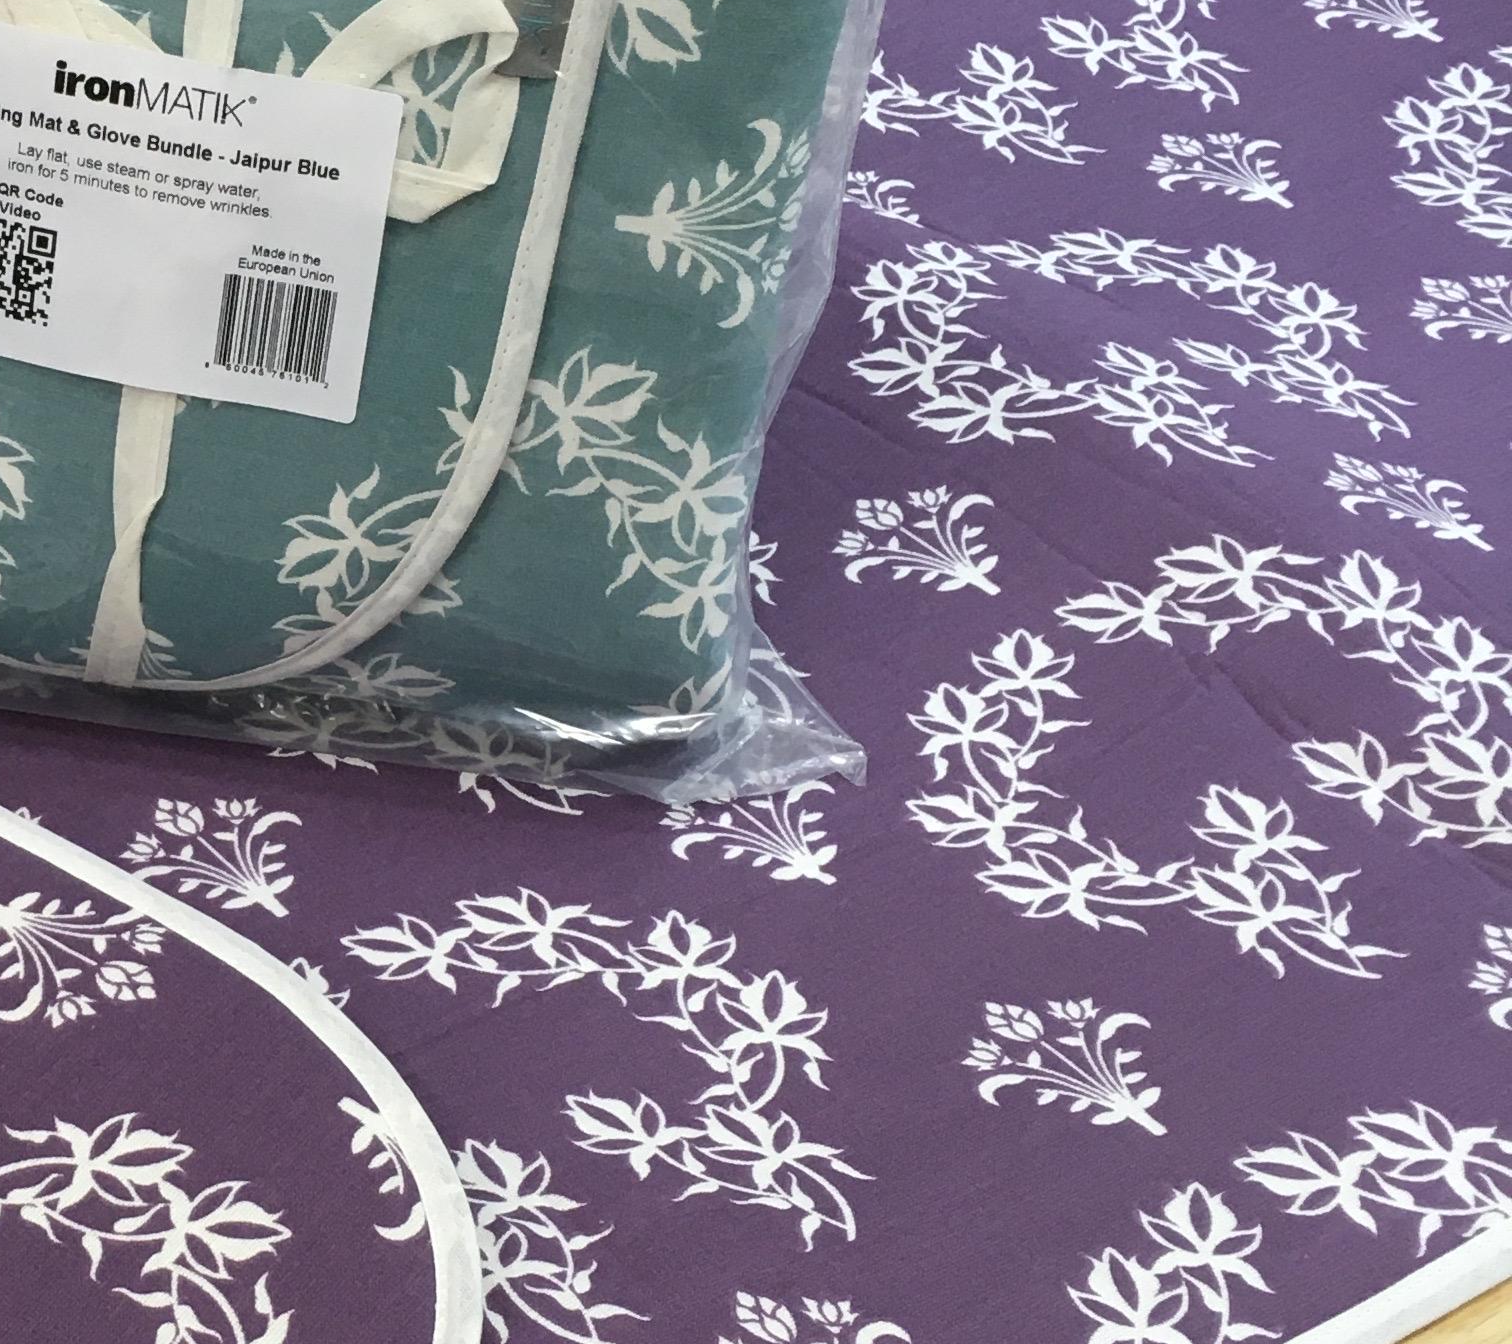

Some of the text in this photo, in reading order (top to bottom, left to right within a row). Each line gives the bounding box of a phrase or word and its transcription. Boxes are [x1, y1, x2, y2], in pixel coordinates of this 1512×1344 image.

[28, 109, 63, 133] Mat
[66, 118, 81, 136] &
[86, 122, 141, 148] Glove
[145, 133, 213, 162] Bundle
[228, 148, 292, 174] Jaipur
[296, 157, 340, 181] Blue
[6, 157, 272, 218] iron for 5 minutes to remove wrinkles.
[16, 141, 260, 202] Lay flat, use steam or spray water,
[23, 187, 64, 208] Code
[237, 256, 335, 284] European Union
[250, 243, 321, 267] Made in the
